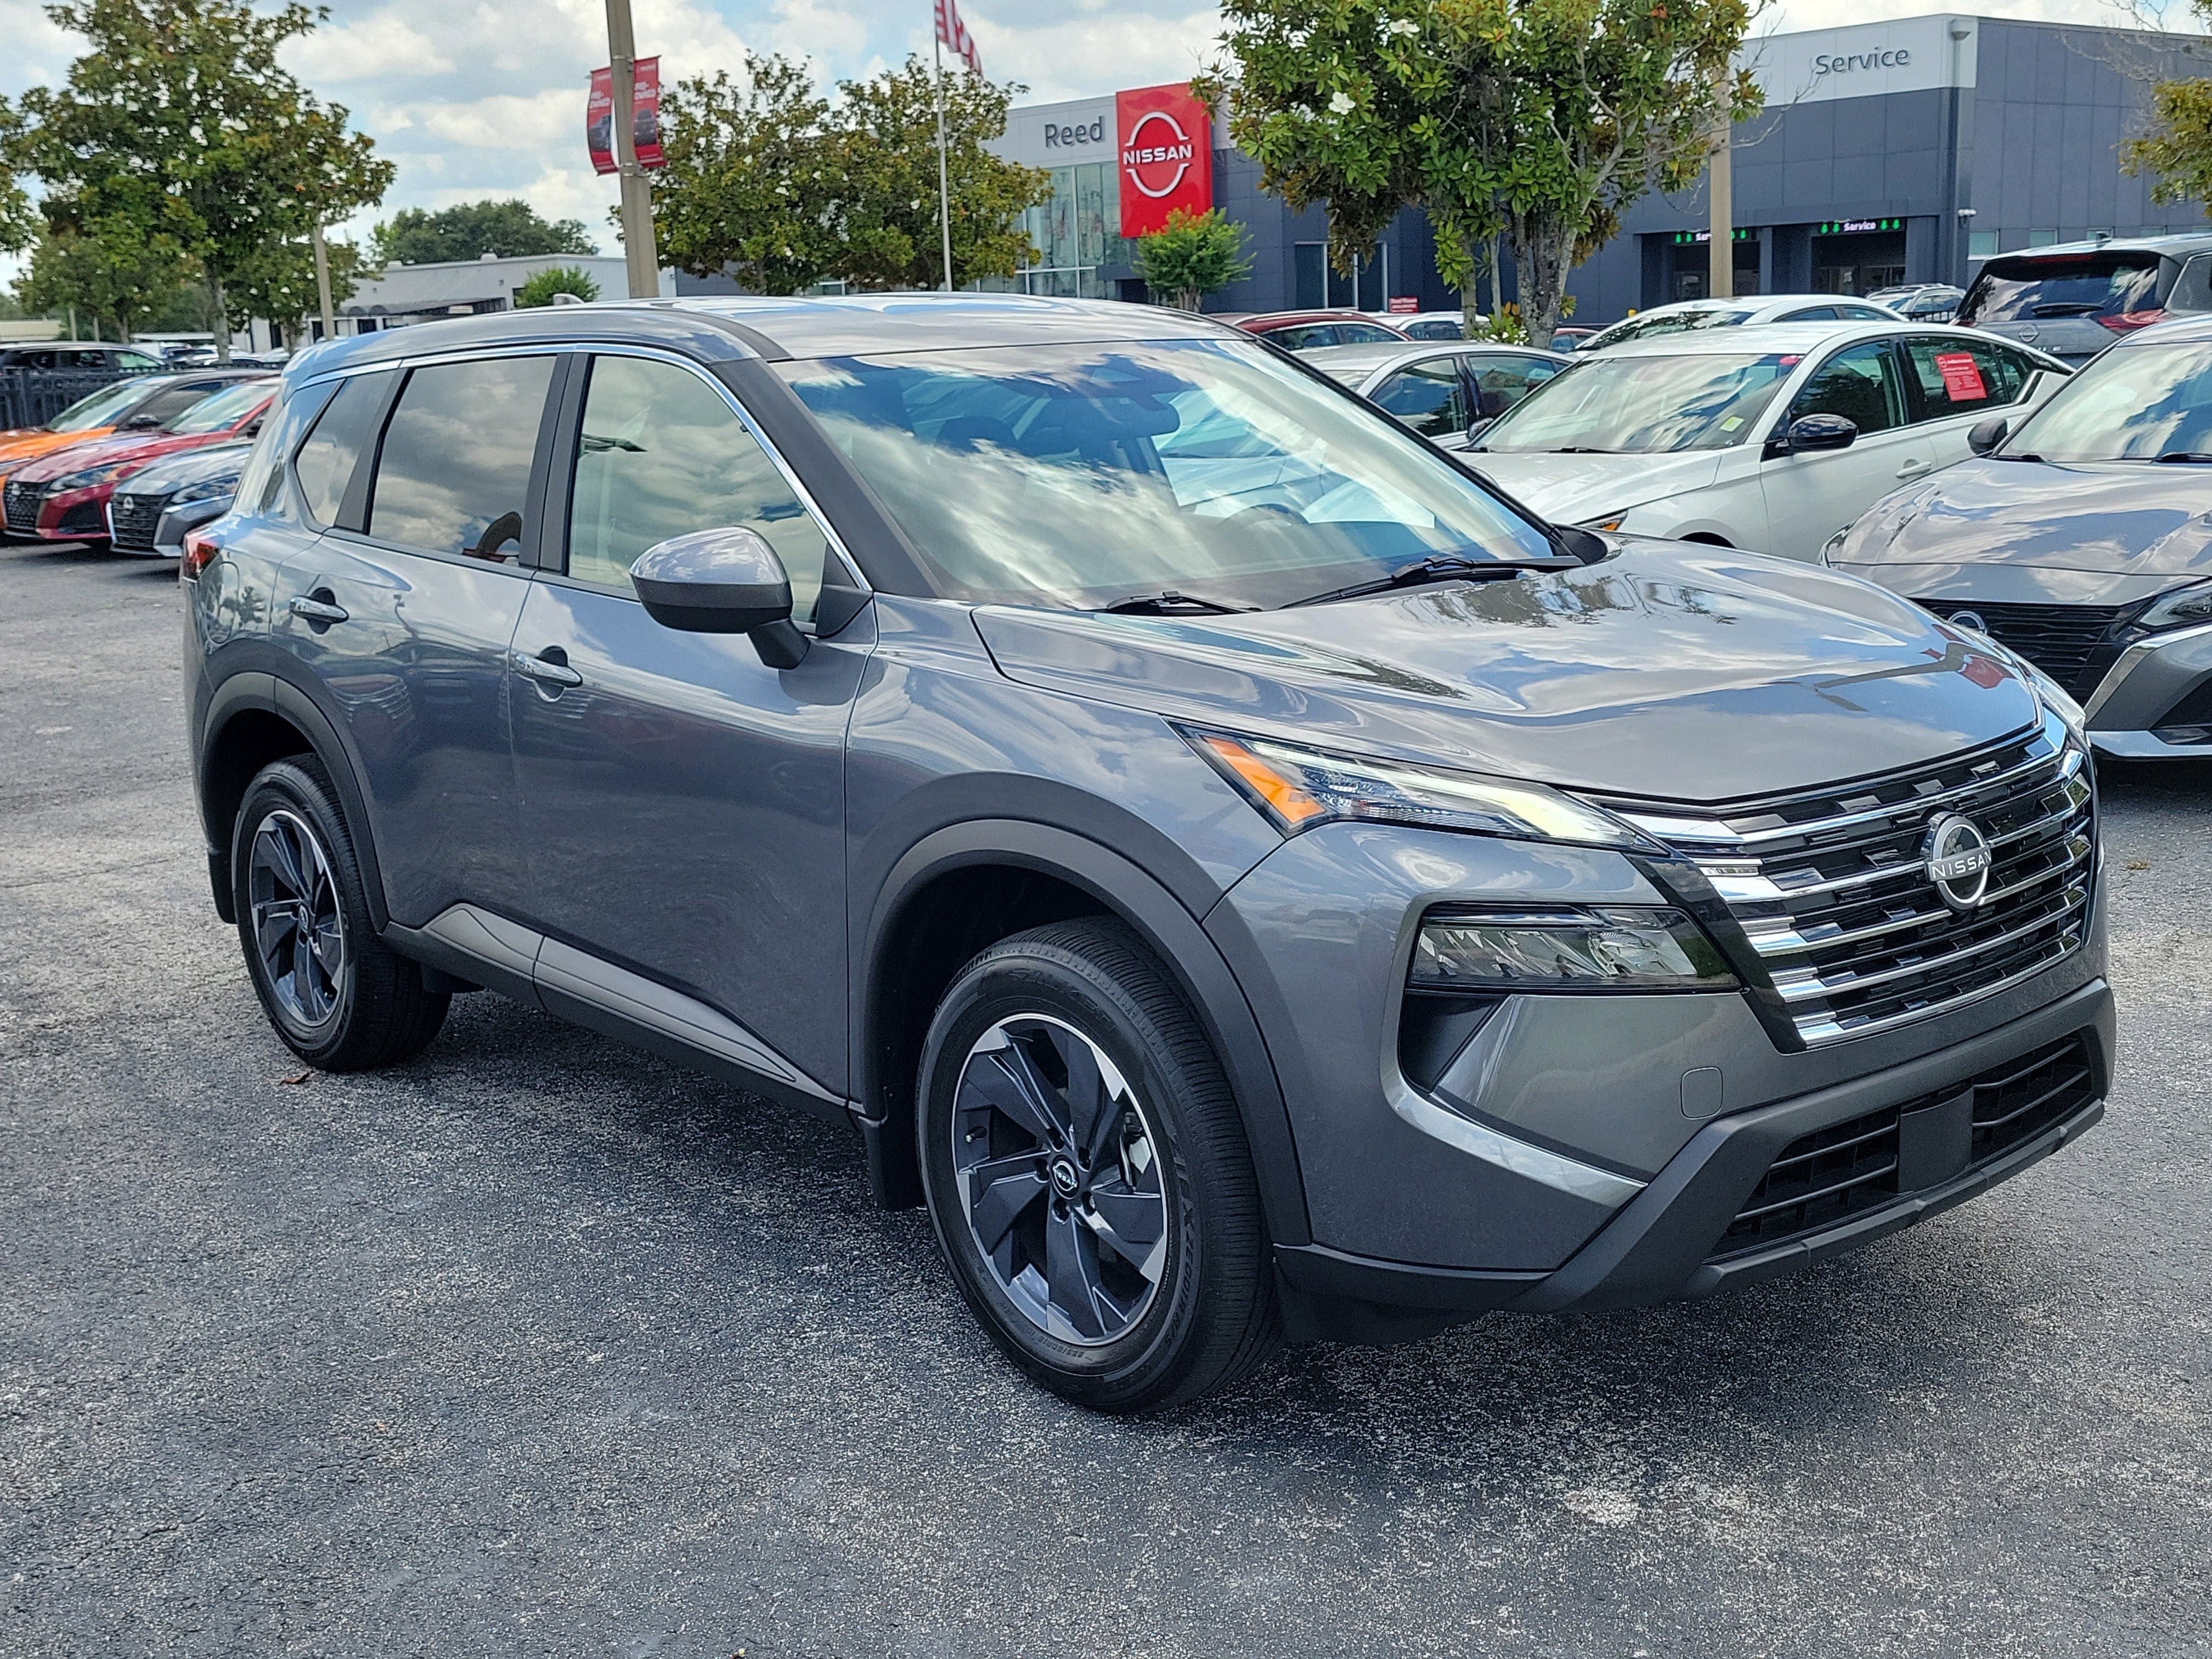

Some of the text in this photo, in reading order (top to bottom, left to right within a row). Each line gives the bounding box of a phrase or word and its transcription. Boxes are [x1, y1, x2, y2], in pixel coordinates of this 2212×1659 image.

[1815, 47, 1910, 75] Service
[1045, 116, 1105, 149] Reed
[1123, 144, 1193, 165] NISSAN
[1843, 221, 1876, 232] Service
[1932, 851, 1991, 878] NISSAN
[1053, 1166, 1078, 1188] NISSAN
